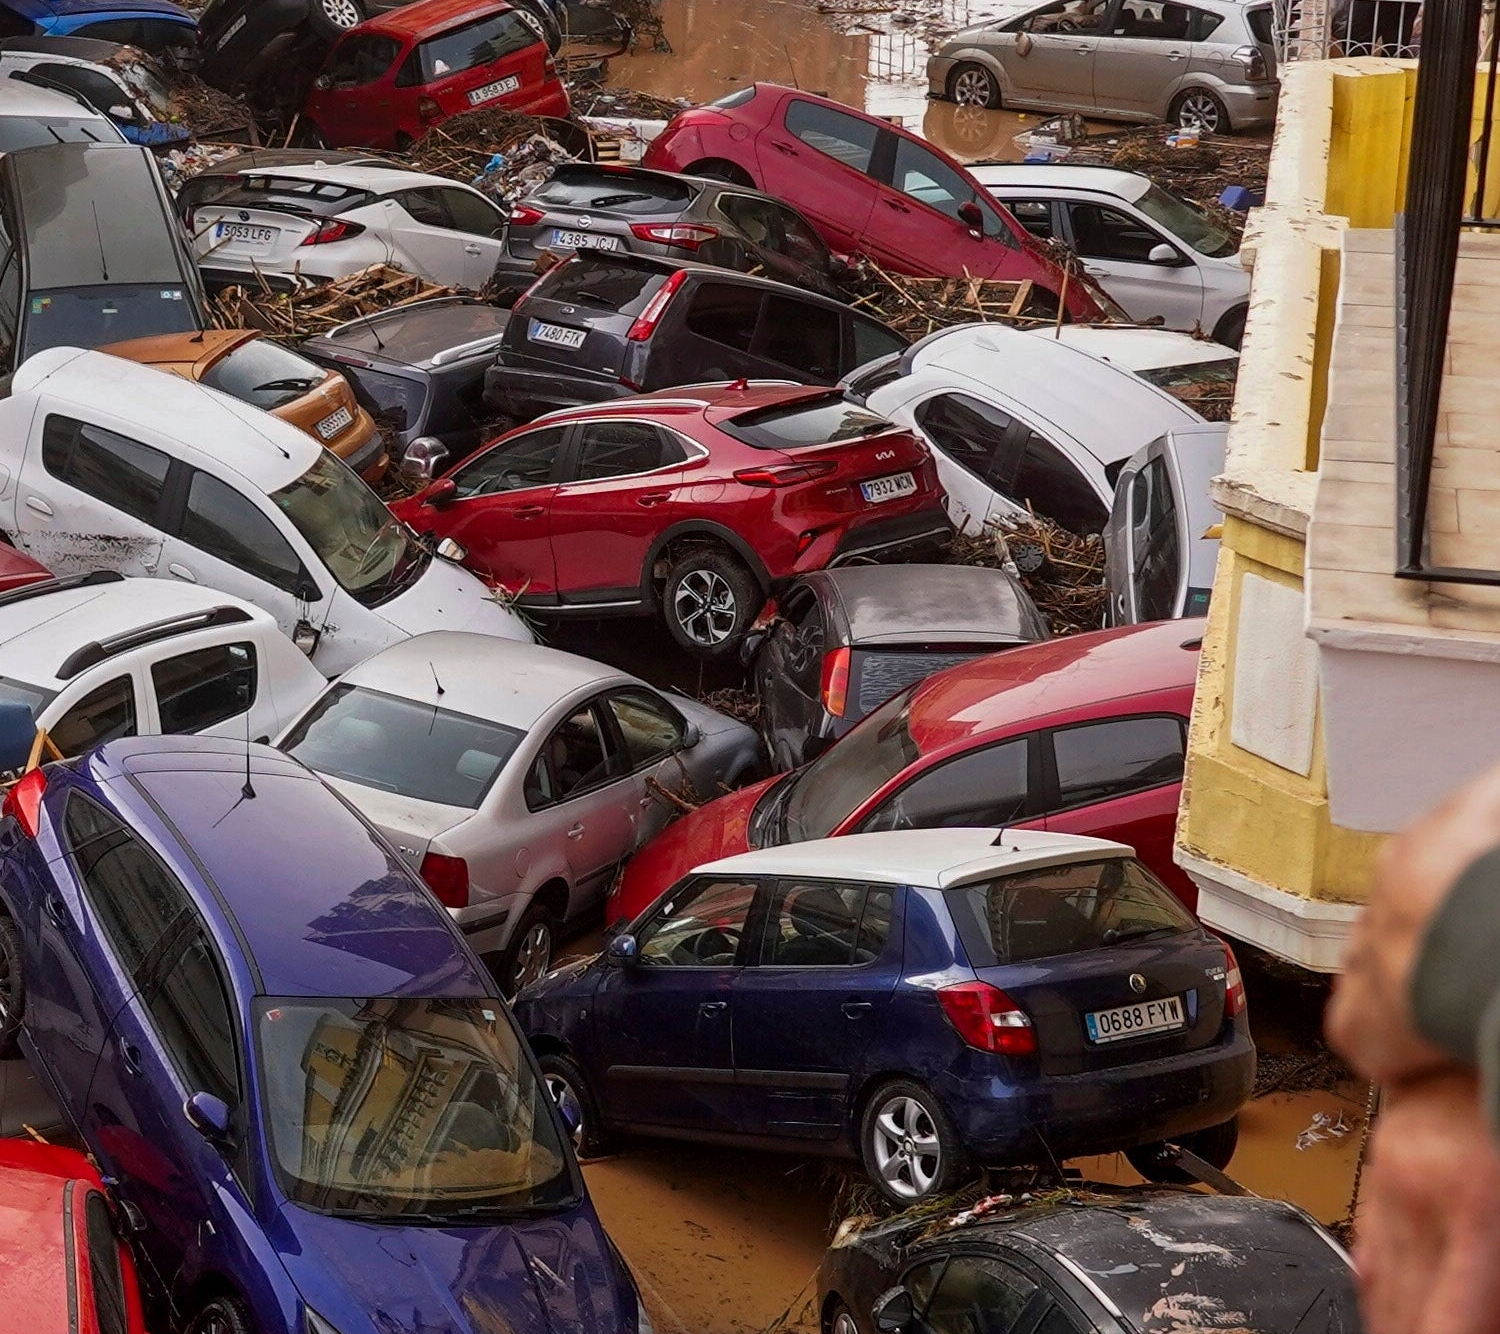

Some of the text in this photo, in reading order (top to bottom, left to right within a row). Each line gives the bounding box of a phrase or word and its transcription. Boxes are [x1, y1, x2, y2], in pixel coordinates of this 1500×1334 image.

[224, 225, 272, 241] 5053 LFG
[559, 233, 615, 251] 4385 JCJ
[538, 323, 584, 346] 7480 FTK
[867, 479, 895, 498] 7932
[1099, 999, 1180, 1034] 0688 FYW
